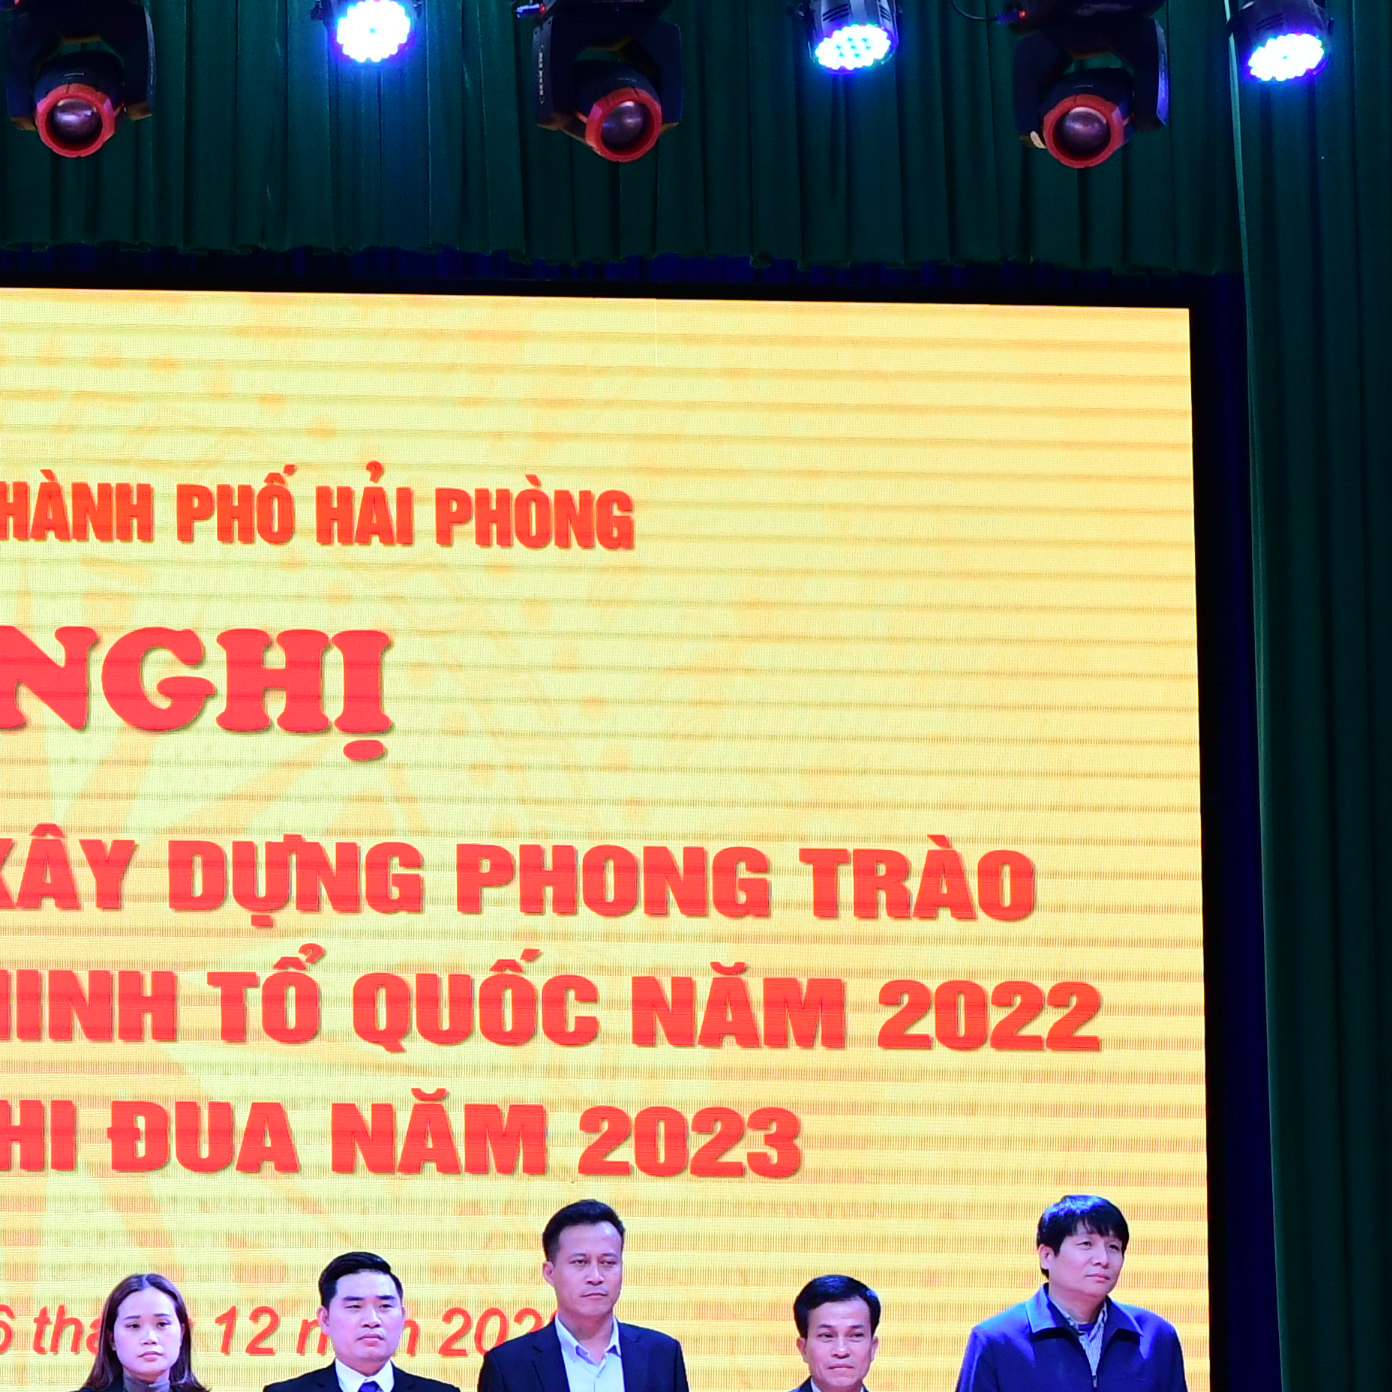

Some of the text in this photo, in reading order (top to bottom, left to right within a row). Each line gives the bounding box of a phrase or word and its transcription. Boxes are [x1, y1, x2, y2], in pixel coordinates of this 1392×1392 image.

[176, 463, 295, 545] PHỐ
[316, 460, 414, 546] HẢI
[435, 475, 634, 551] PHÒNG
[168, 834, 424, 929] DỰNG
[456, 843, 771, 919] PHONG
[799, 833, 1036, 923] TRÀO
[207, 942, 325, 1045] TỔ
[353, 948, 600, 1053] QUỐC
[631, 960, 847, 1050] NĂM
[876, 978, 1102, 1052] 2022
[107, 1100, 300, 1174] ĐUA
[331, 1087, 547, 1177] NĂM
[577, 1105, 802, 1180] 2023
[214, 1304, 280, 1355] 12
